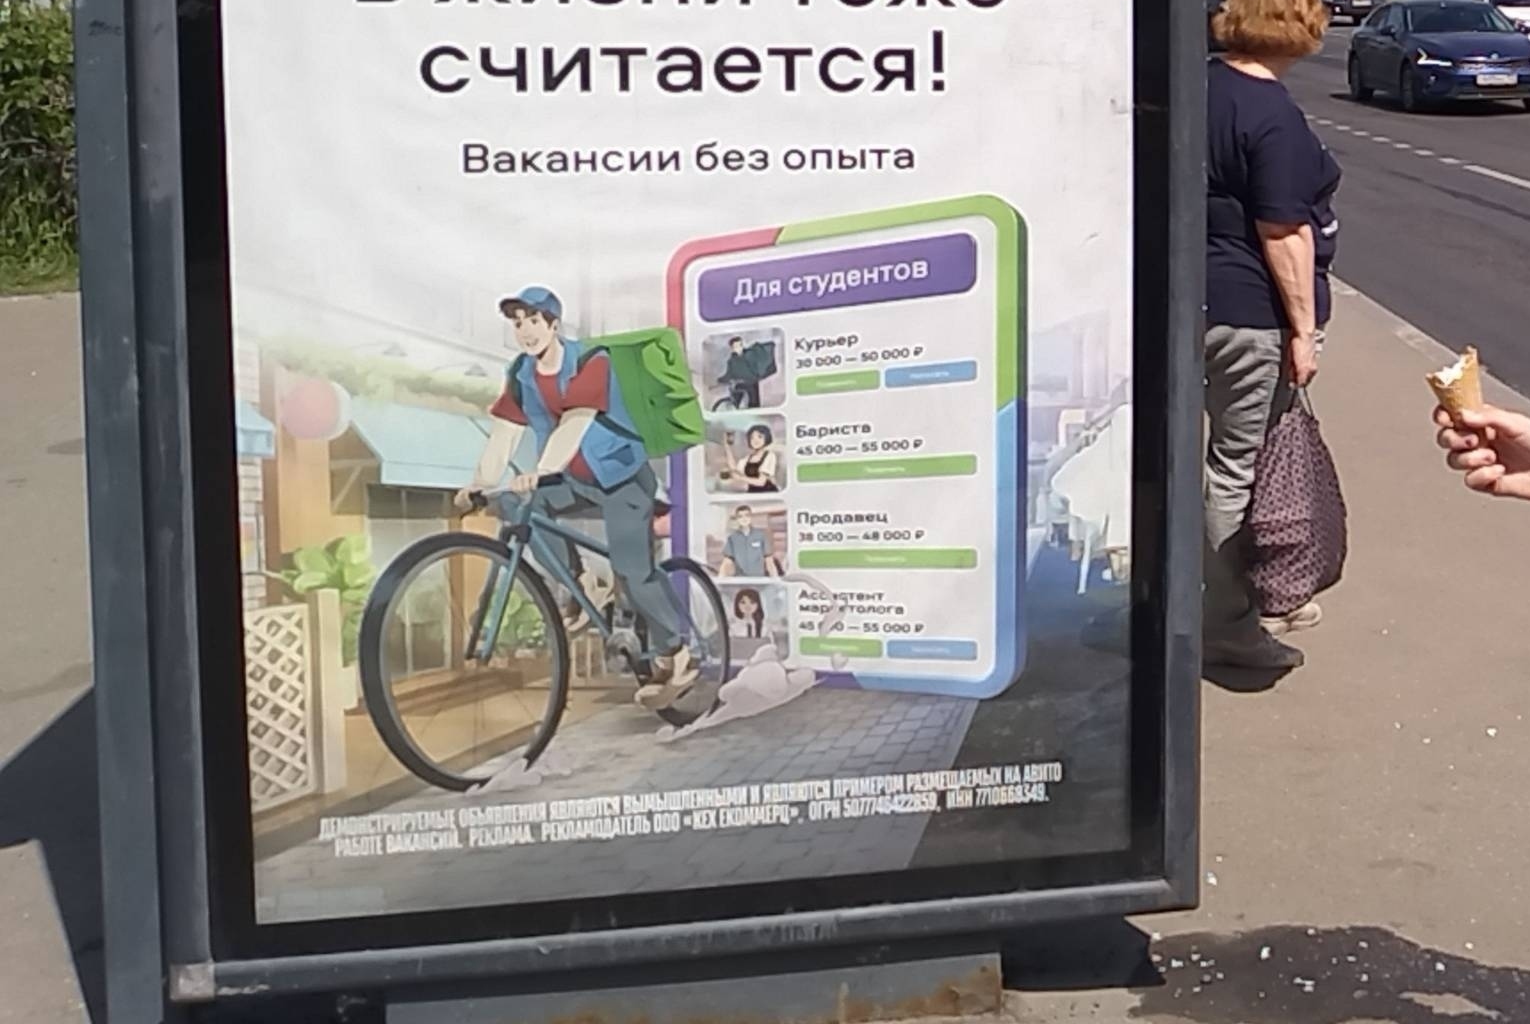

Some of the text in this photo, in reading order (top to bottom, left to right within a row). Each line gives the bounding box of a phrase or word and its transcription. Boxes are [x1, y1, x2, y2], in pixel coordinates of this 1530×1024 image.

[420, 31, 947, 95] считается!
[462, 142, 915, 175] Вакансии без опыта
[734, 259, 929, 305] Для студентов
[795, 334, 859, 352] Курьер
[815, 355, 842, 367] 000
[861, 351, 879, 362] 50
[881, 348, 910, 359] 000
[796, 424, 872, 439] Бариста
[815, 444, 842, 455] 000
[861, 441, 878, 453] 55
[881, 439, 910, 451] 000
[797, 512, 889, 526] Продавец
[817, 531, 844, 542] 000
[862, 530, 880, 541] 48
[883, 530, 911, 541] 000
[798, 604, 905, 616] маретолога
[817, 621, 845, 632] 00
[863, 623, 880, 634] 55
[882, 623, 911, 634] 000
[319, 807, 457, 841] ДЕМОНСТРИРУЕМЫЕ
[459, 801, 547, 828] ОБЪЯВЛЕНИЯ
[549, 795, 620, 820] ЯВЛЯЮТСЯ
[622, 786, 748, 814] ВЫМЫШЛЕННЫМИ
[750, 784, 760, 805] И
[833, 774, 904, 798] ПРИМЕРОМ
[906, 766, 1003, 793] РАЗМЕЩАЕМЫХ
[1004, 765, 1021, 784] НА
[1023, 761, 1063, 783] АВИТО
[334, 834, 384, 857] РАБОТЕ
[469, 823, 535, 848] РЕКЛАМА.
[541, 814, 651, 842] РЕКЛАМОДАТЕЛЬ
[653, 811, 681, 833] ООО
[808, 799, 841, 821] ОГРН
[946, 789, 973, 810] ИНН
